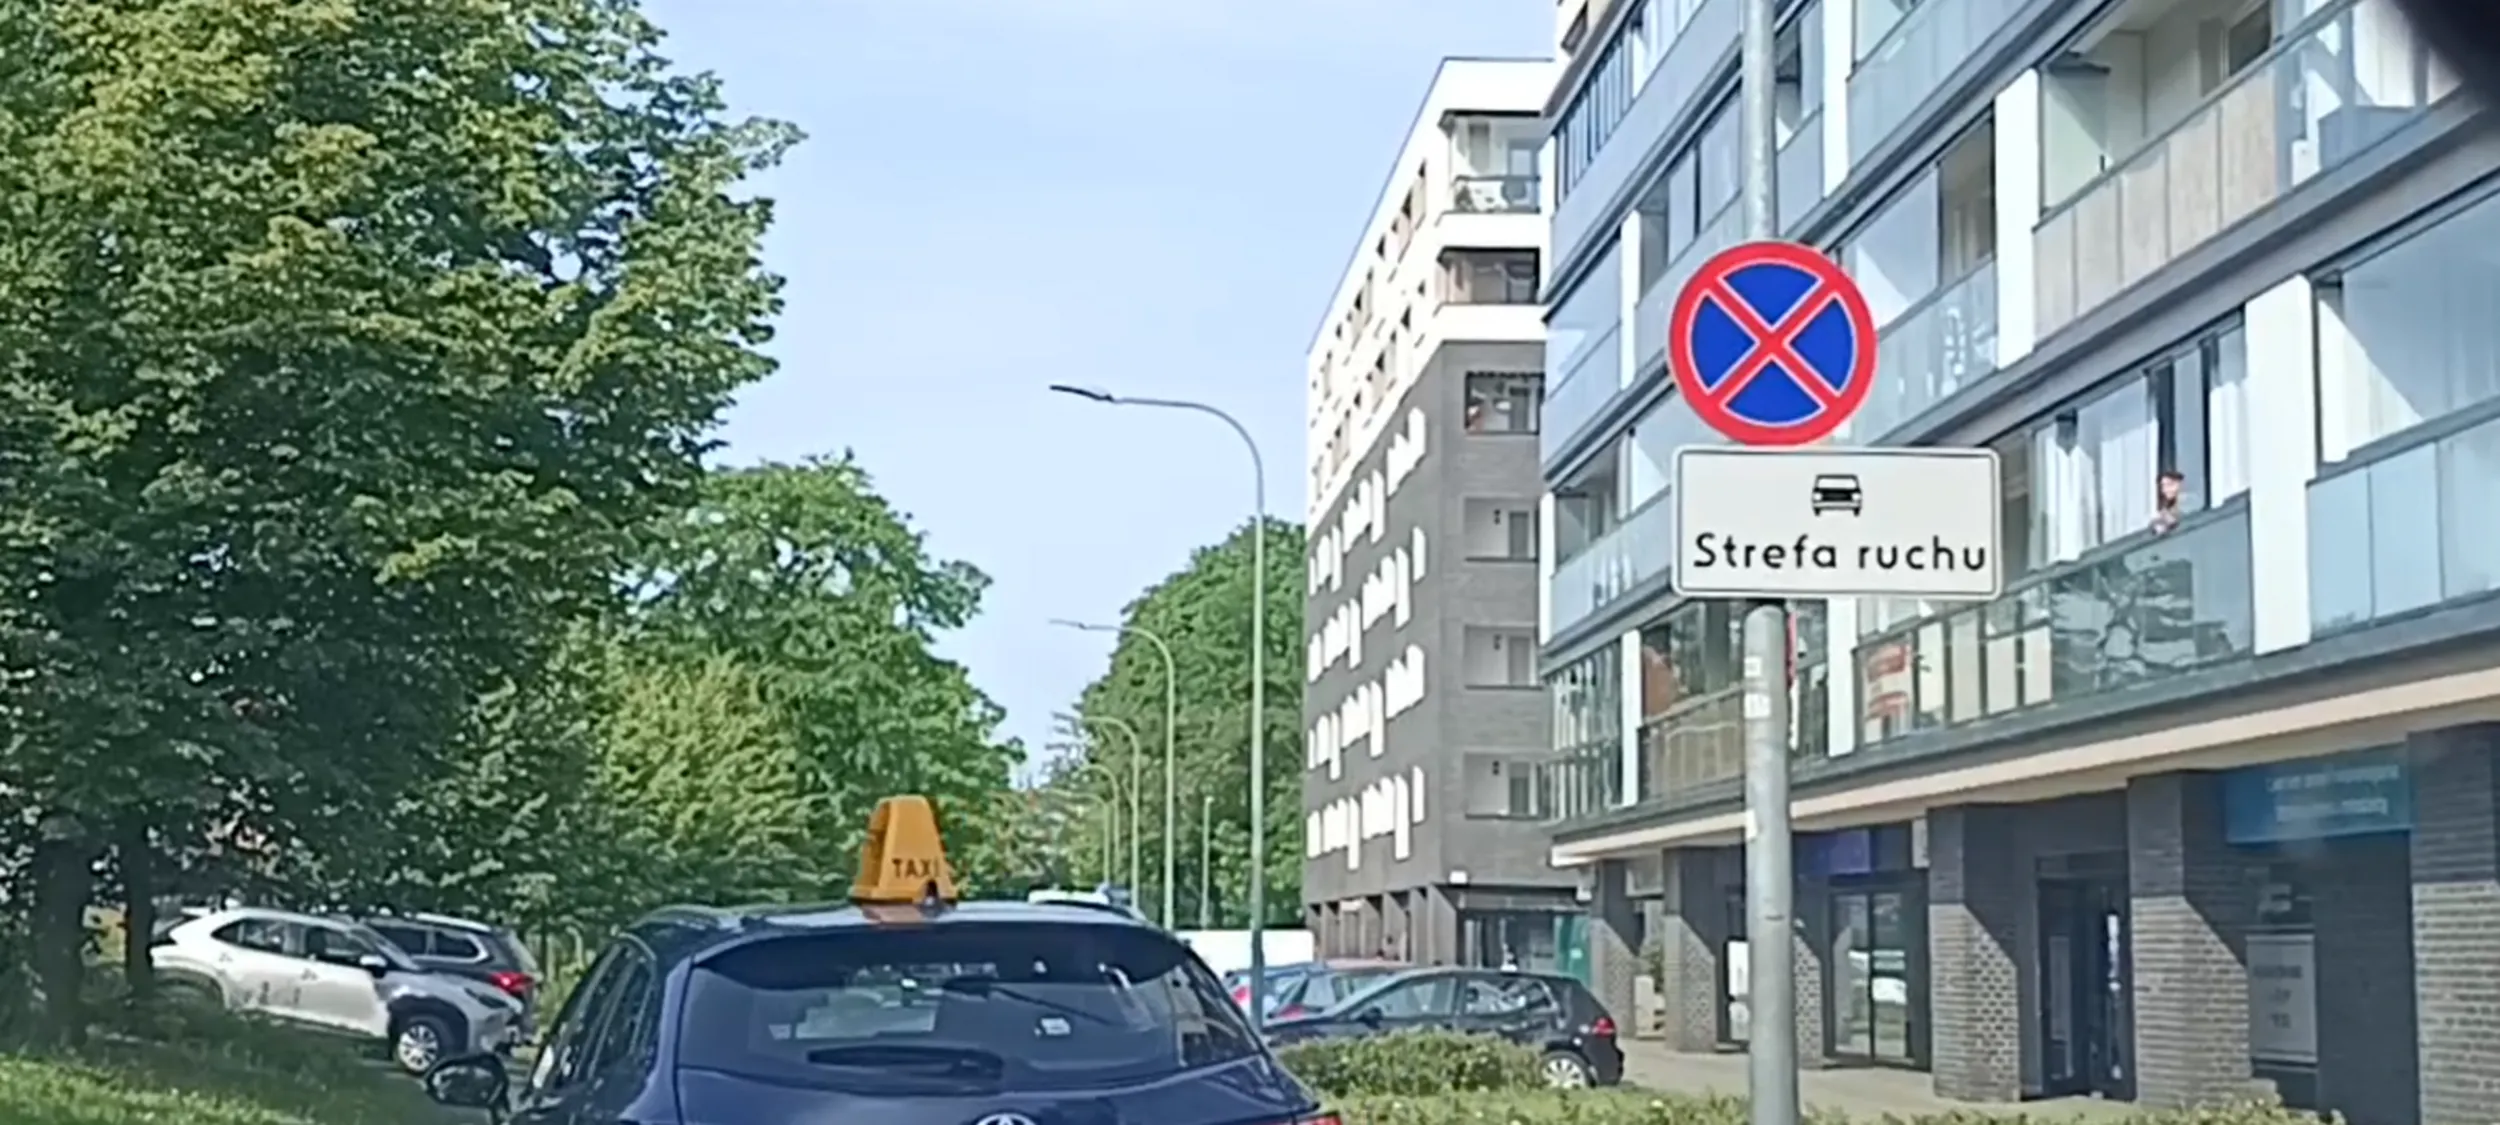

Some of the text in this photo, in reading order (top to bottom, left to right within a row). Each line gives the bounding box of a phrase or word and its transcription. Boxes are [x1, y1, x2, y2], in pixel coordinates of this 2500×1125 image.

[1693, 532, 1986, 570] Strefa ruchu
[892, 858, 939, 878] TAXI
